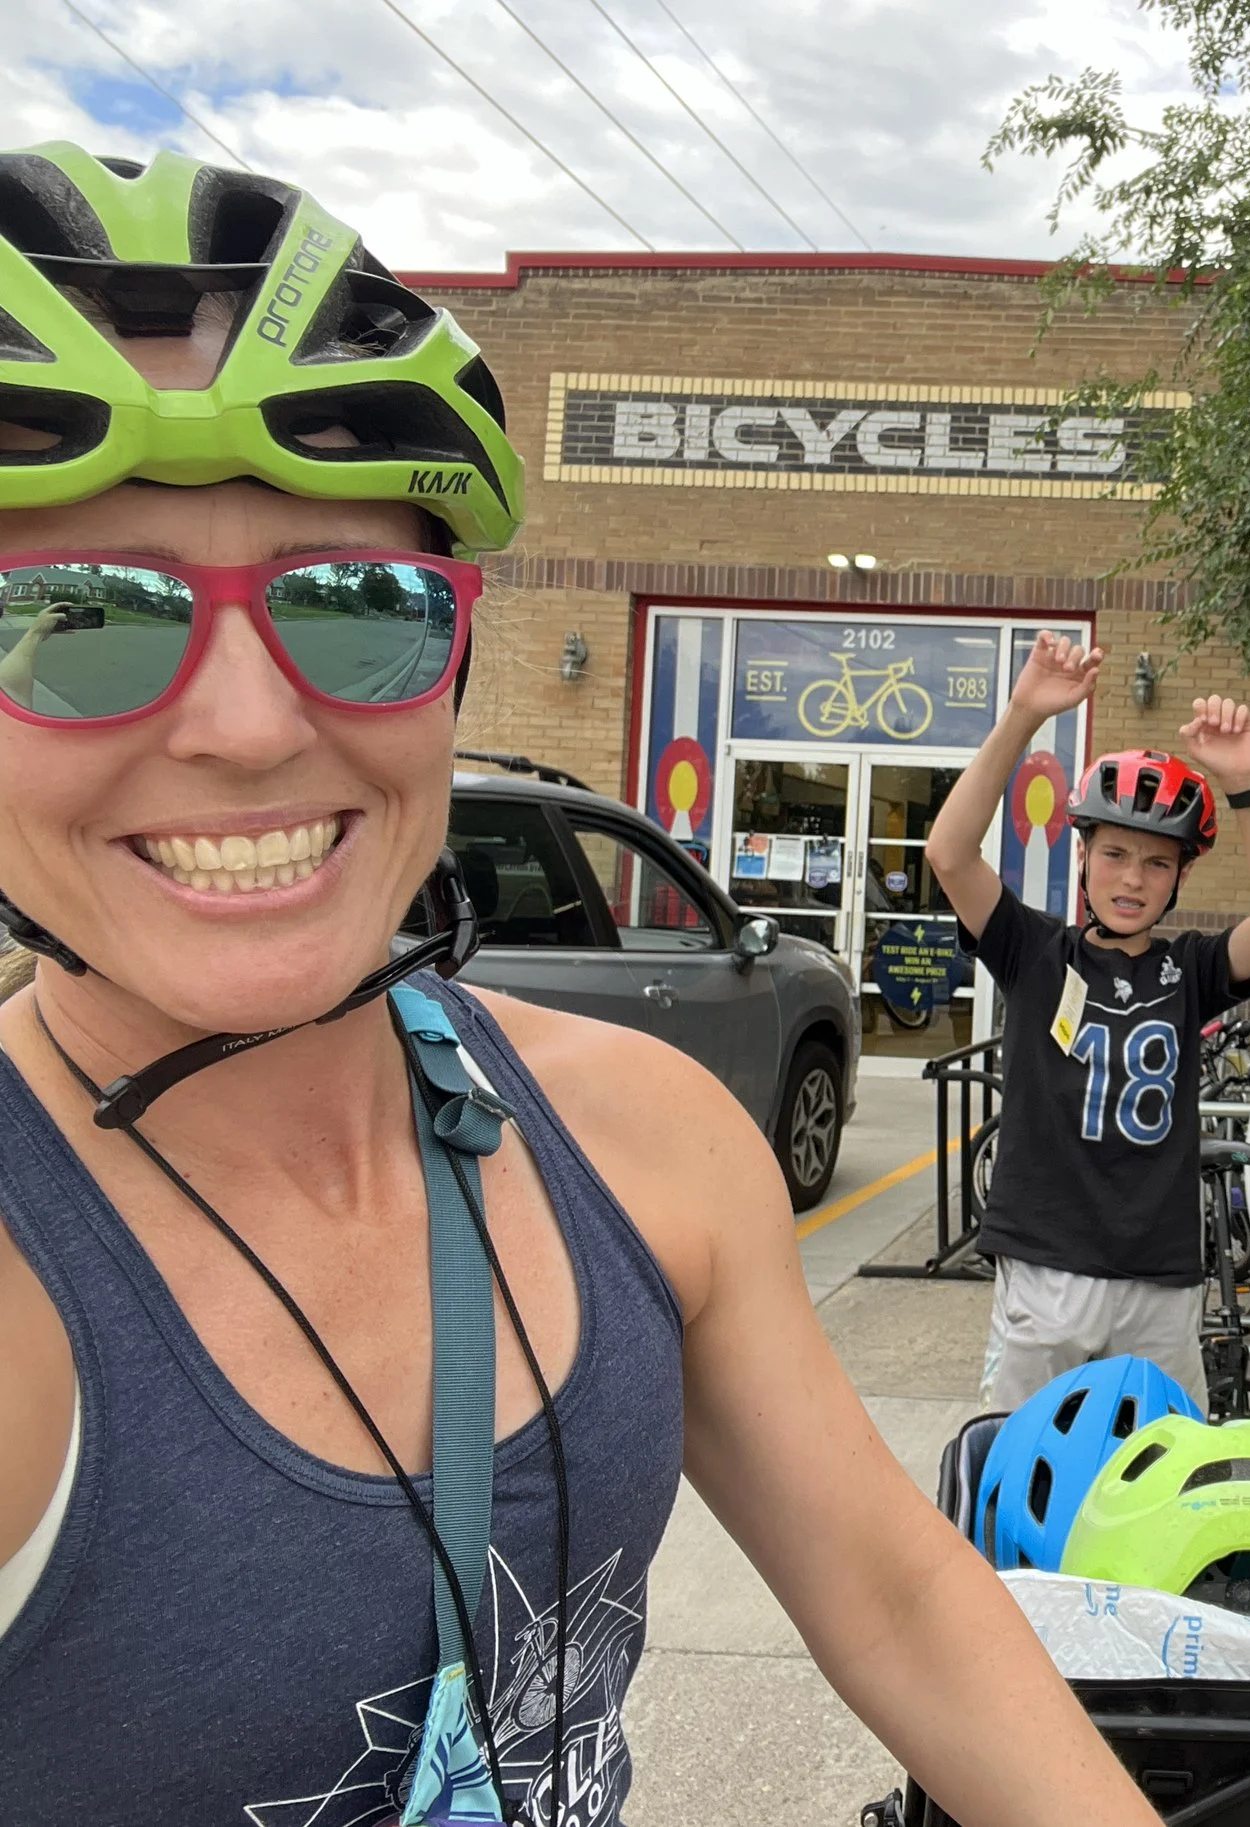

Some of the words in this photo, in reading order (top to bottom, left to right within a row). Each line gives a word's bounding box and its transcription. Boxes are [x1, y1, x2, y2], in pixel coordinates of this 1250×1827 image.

[613, 401, 1127, 472] BICYCLES
[408, 470, 472, 495] KASK
[842, 629, 895, 649] 2102
[746, 670, 787, 692] EST.
[948, 676, 987, 698] 1983
[883, 946, 899, 955] TEST
[902, 947, 917, 956] RIDE
[919, 948, 929, 956] AN
[904, 956, 919, 965] WIN
[921, 957, 931, 966] AN
[888, 965, 924, 975] AWESOME
[926, 967, 946, 977] PRIZE
[222, 1034, 264, 1052] ITALY
[1071, 1019, 1179, 1146] 18
[1183, 1615, 1204, 1679] prim
